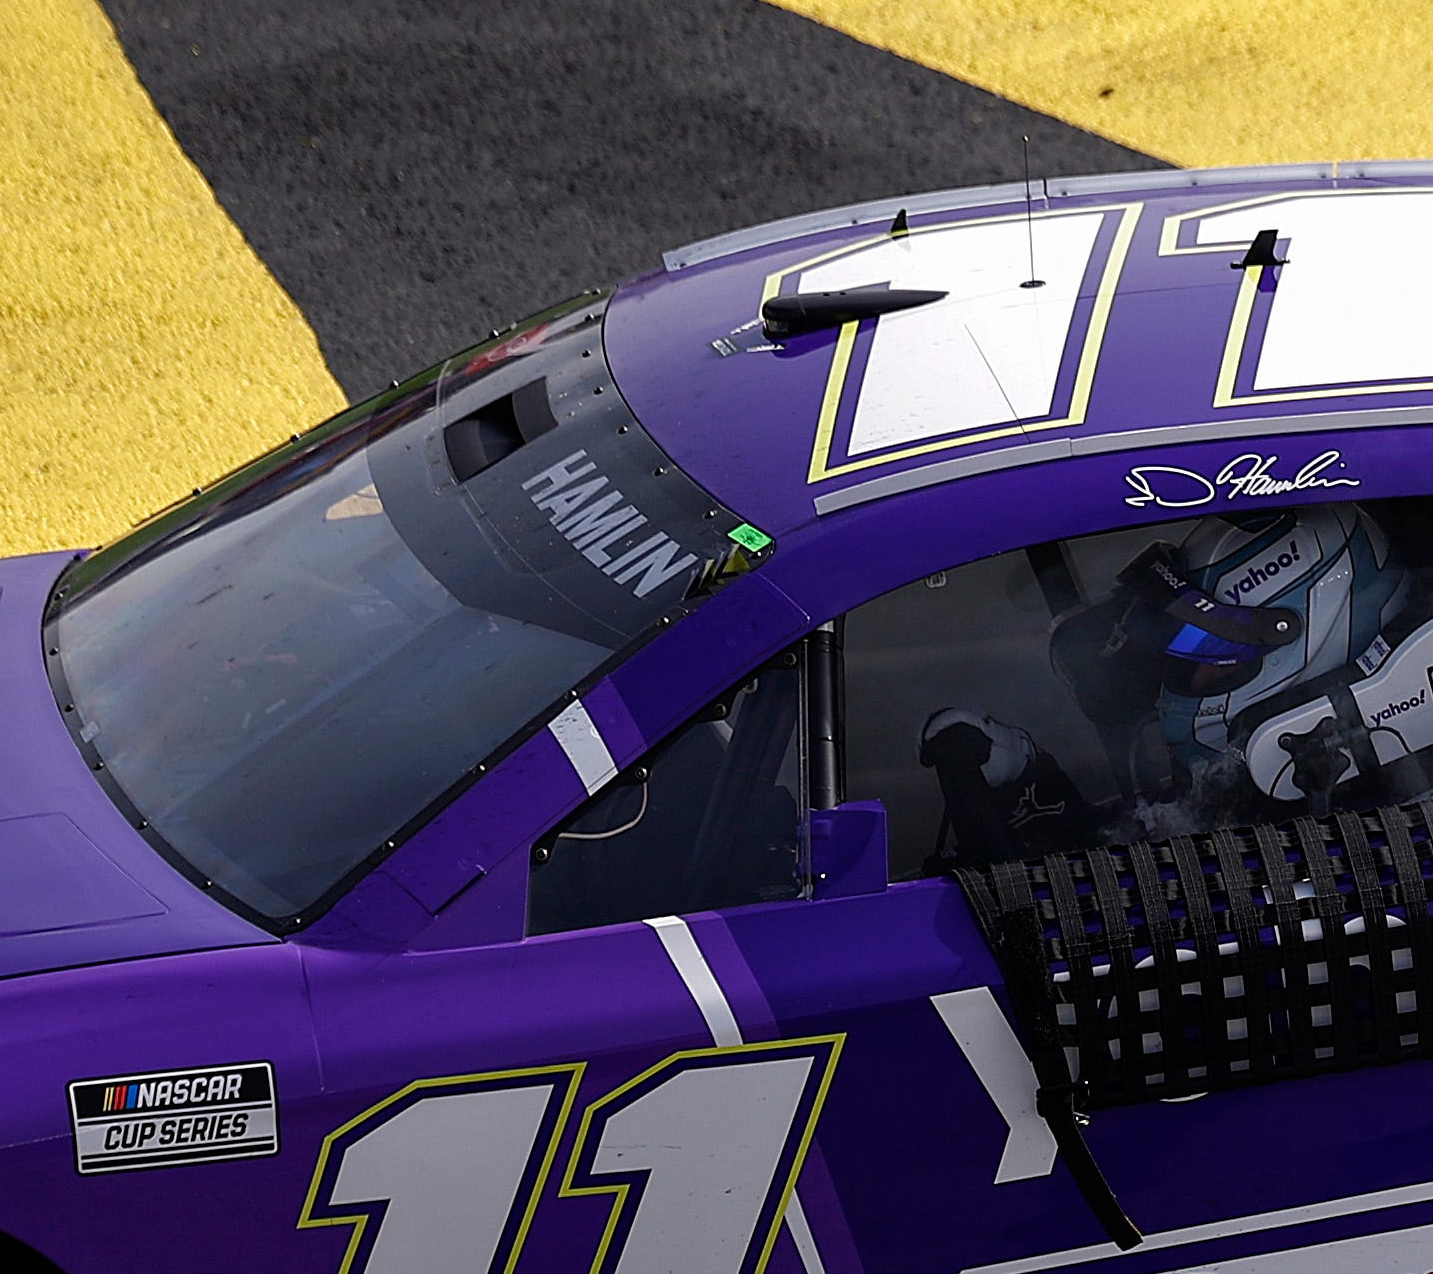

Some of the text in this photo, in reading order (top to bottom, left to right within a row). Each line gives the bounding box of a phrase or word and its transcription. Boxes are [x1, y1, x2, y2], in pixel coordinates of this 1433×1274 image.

[521, 449, 698, 598] HAMLIN
[1224, 540, 1301, 606] yahoo!
[1194, 598, 1216, 613] 11
[1370, 688, 1425, 726] yahoo!
[137, 1073, 243, 1108] NASCAR
[104, 1113, 249, 1151] CUP SERIES
